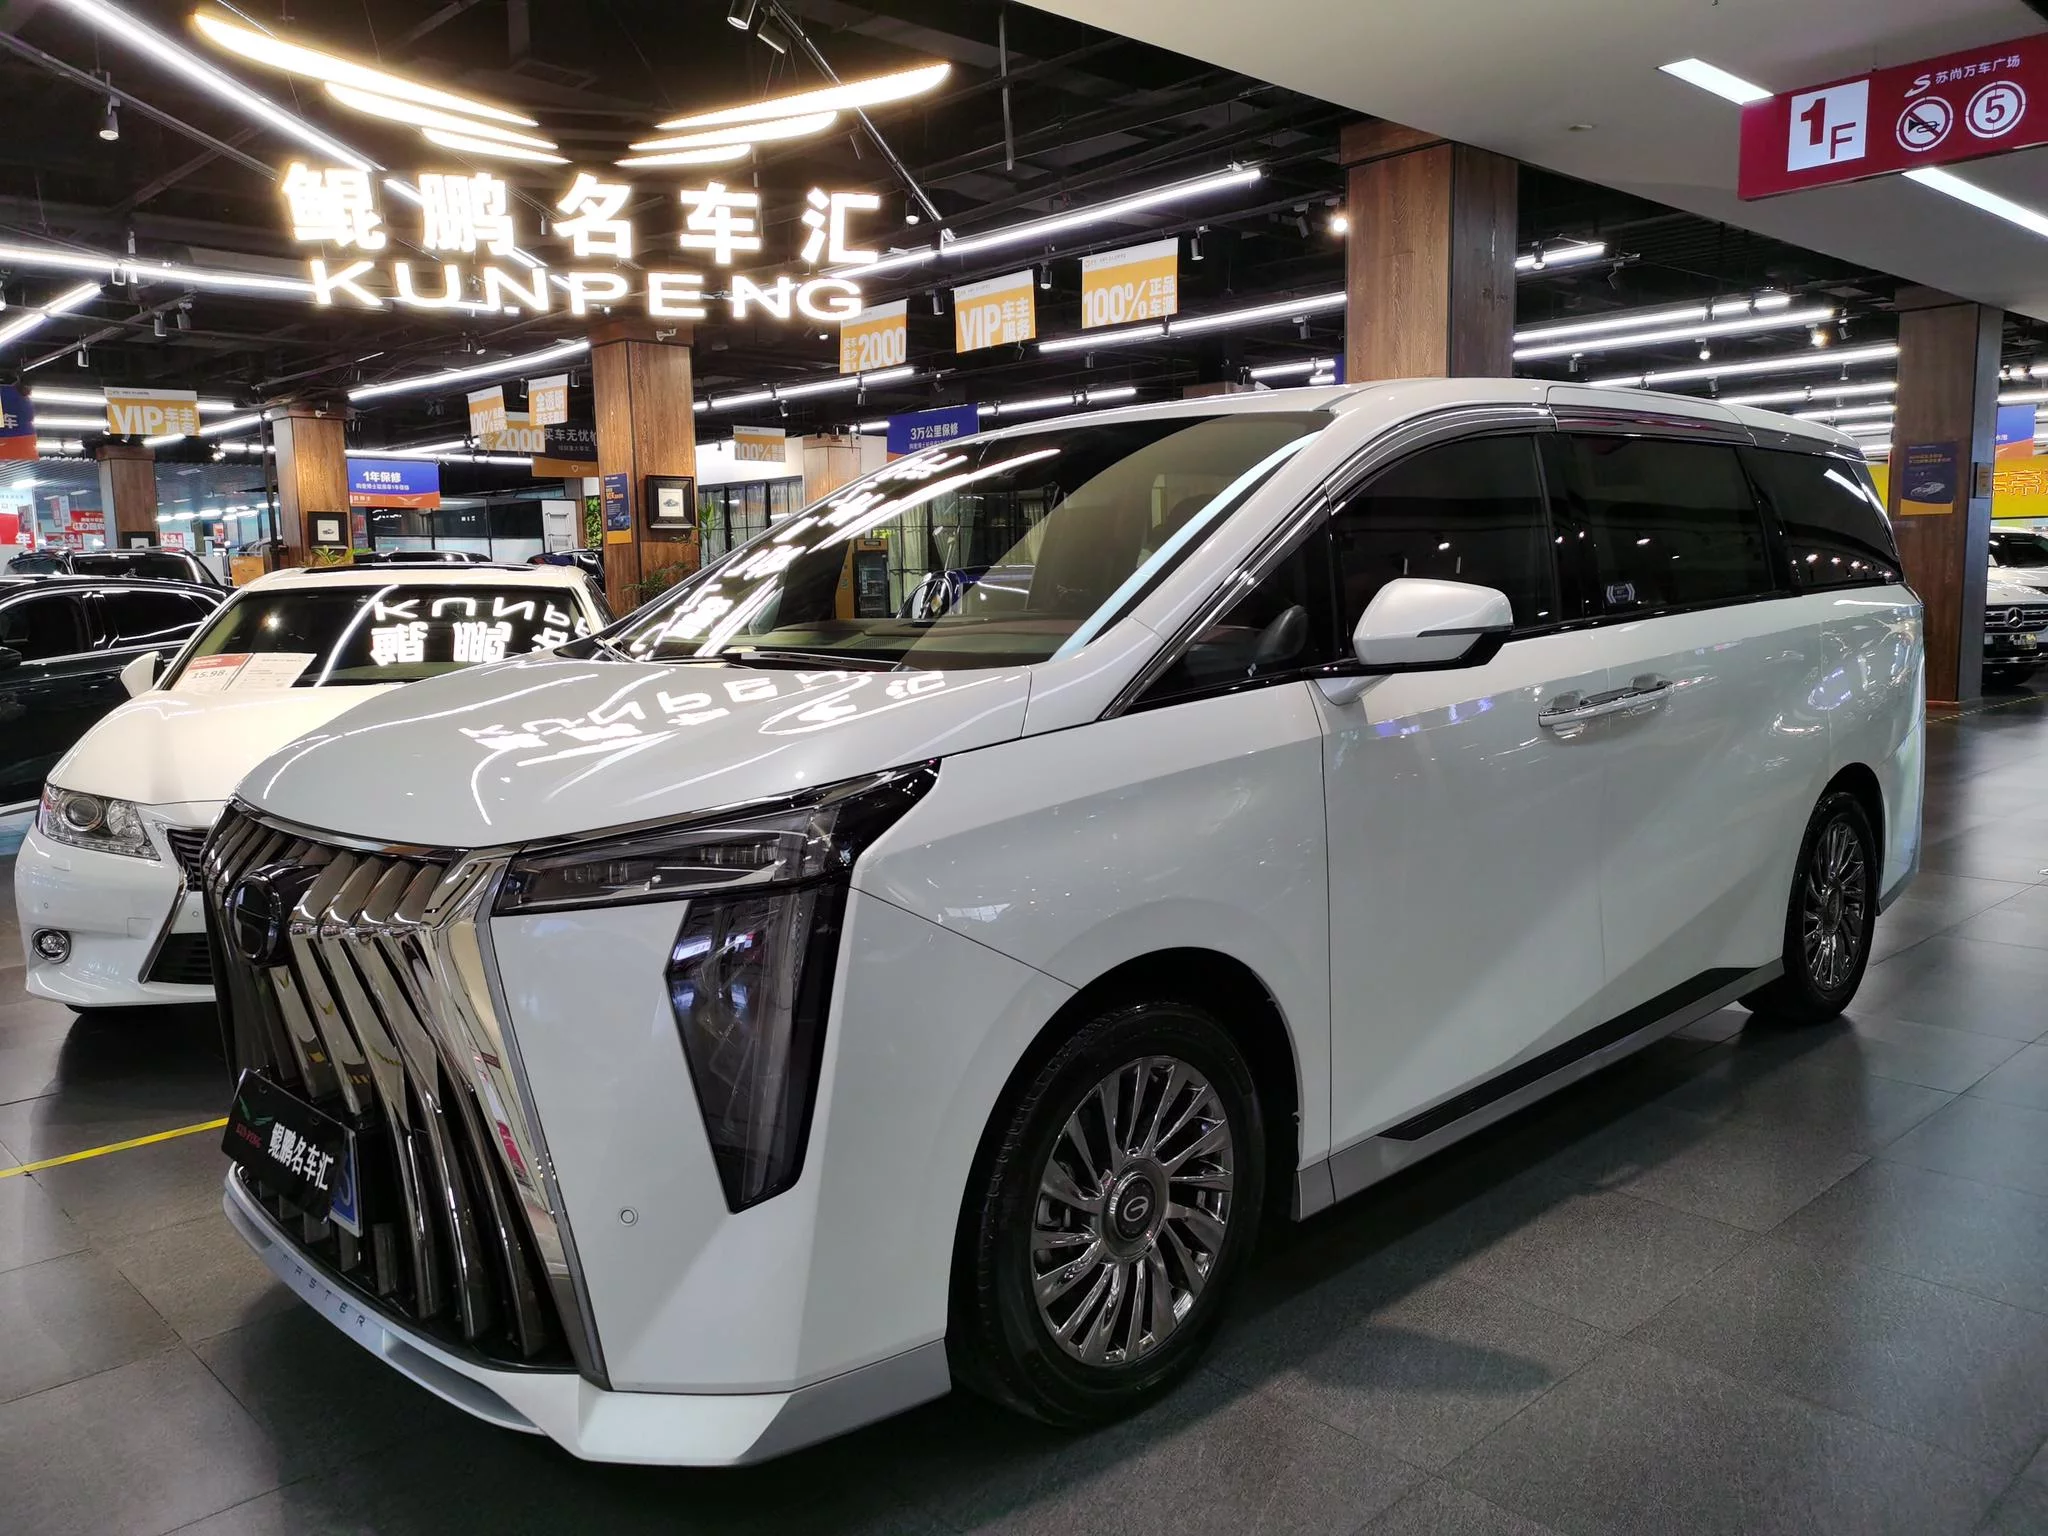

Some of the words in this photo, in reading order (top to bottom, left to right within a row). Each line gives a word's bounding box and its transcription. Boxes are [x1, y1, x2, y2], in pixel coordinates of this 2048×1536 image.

[1936, 55, 2020, 84] 苏尚万车广场
[1985, 94, 2006, 124] 5
[282, 161, 880, 264] 鲲鹏名车汇
[310, 260, 862, 320] KUNPENG
[1083, 280, 1147, 328] 100%
[1002, 297, 1029, 320] 车主
[959, 303, 1001, 351] VIP
[1003, 319, 1030, 343] 服务
[859, 326, 906, 370] 2000
[111, 404, 163, 434] VIP
[910, 422, 959, 440] 3万公里保修
[496, 427, 545, 453] 2000
[363, 471, 401, 482] 1年保修
[267, 1121, 335, 1191] 鲲鹏名车汇
